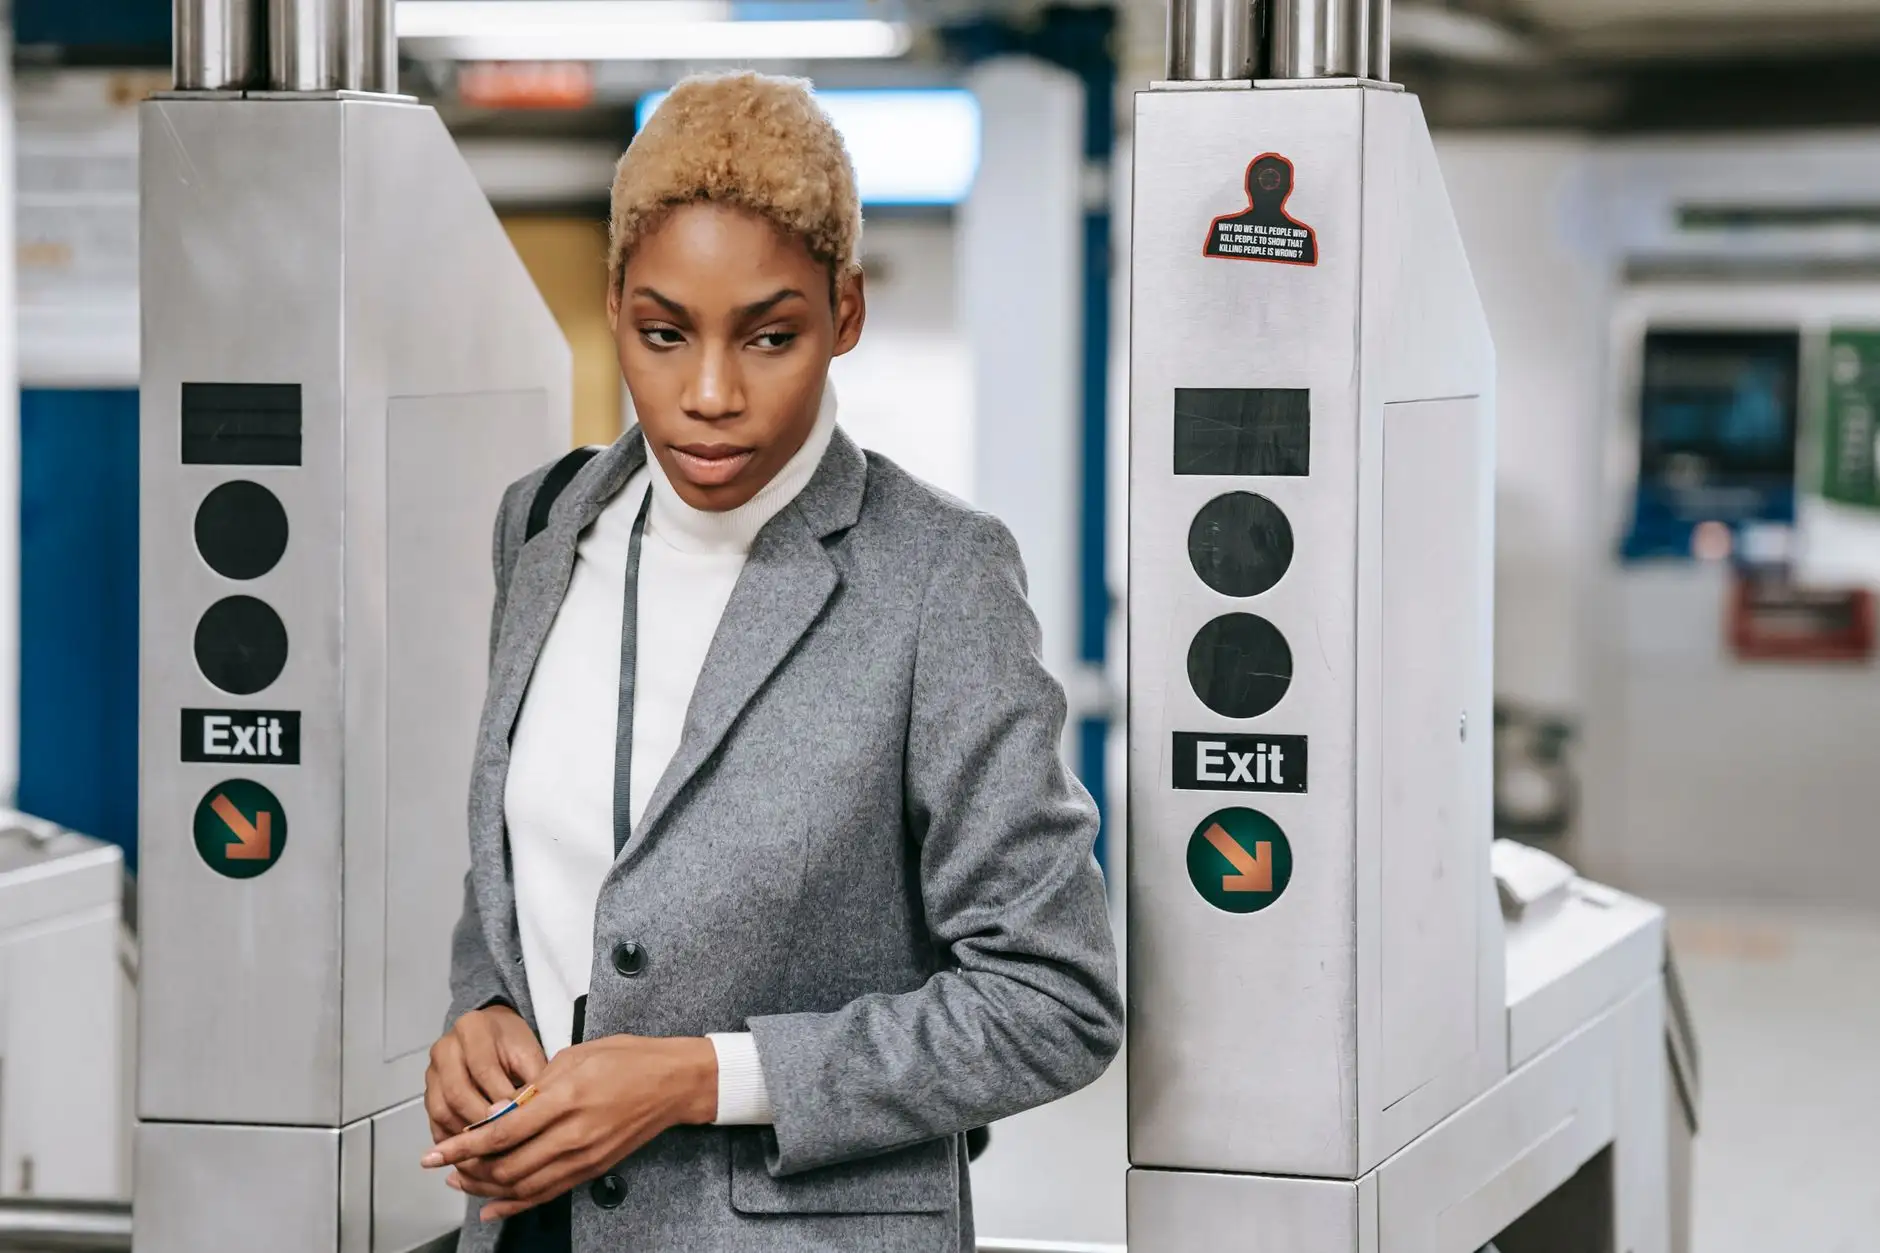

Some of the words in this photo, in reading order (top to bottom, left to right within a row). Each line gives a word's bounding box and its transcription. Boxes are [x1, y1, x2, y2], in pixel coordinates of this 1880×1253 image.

[1218, 222, 1234, 232] WHY
[1233, 223, 1243, 233] DO
[1243, 224, 1254, 234] WE
[1254, 225, 1268, 235] KILL
[1268, 226, 1292, 237] PEOPLE
[1292, 228, 1308, 238] WHO
[1220, 233, 1234, 243] KILL
[1234, 234, 1258, 245] PEOPLE
[1258, 236, 1267, 245] TO
[1267, 237, 1287, 247] SHOW
[1287, 238, 1304, 248] THAT
[1218, 243, 1243, 254] KILLING
[1243, 245, 1267, 256] PEOPLE
[1267, 247, 1274, 256] IS
[1274, 248, 1298, 258] WRONG
[203, 715, 283, 757] Exit
[1196, 740, 1284, 784] Exit
